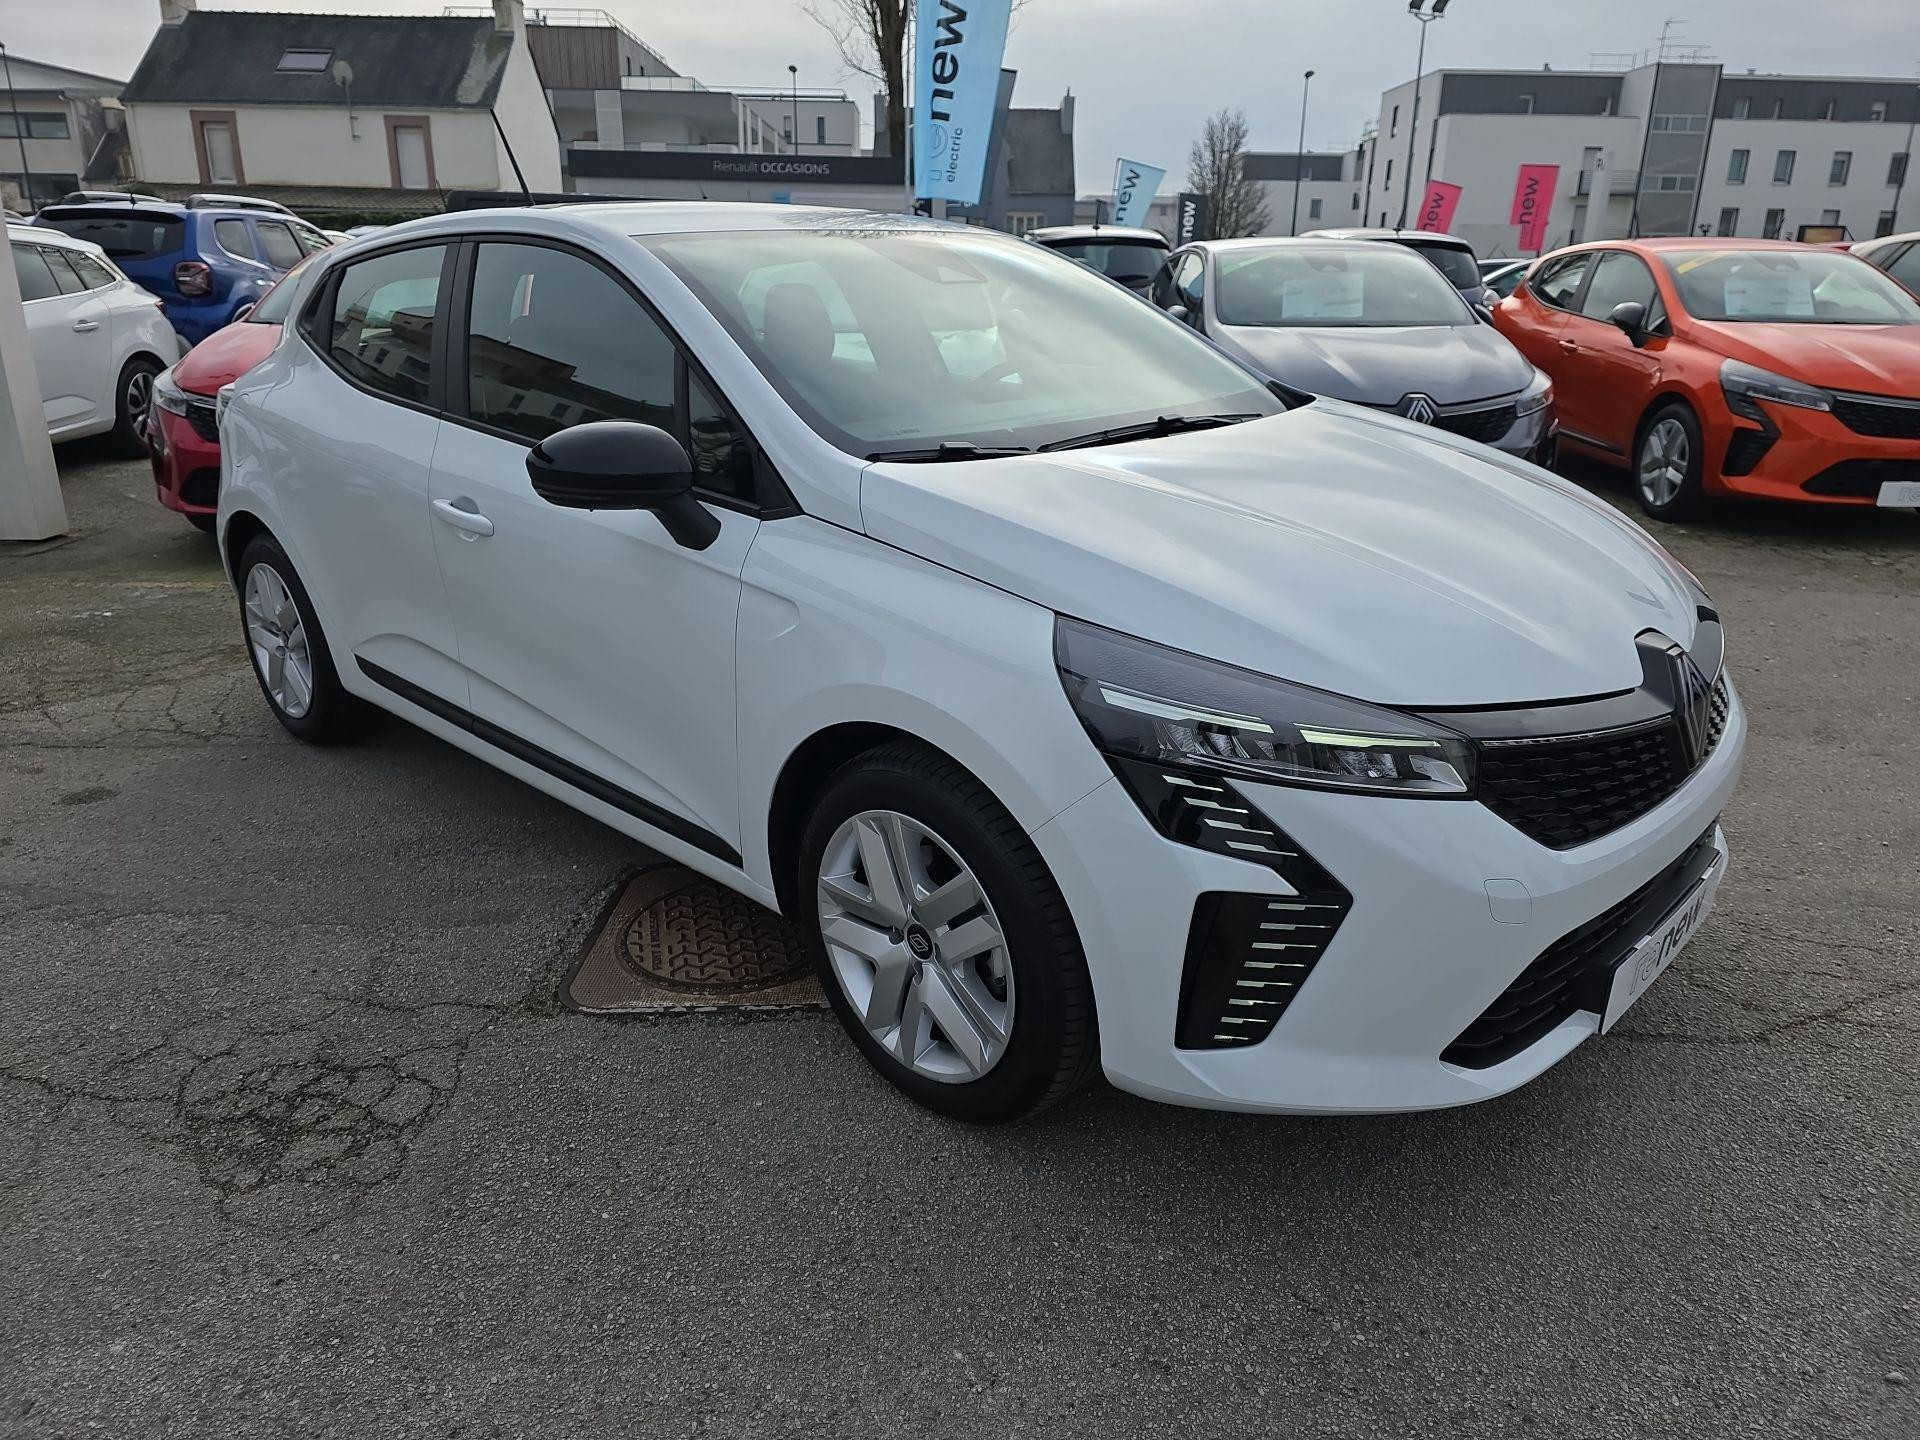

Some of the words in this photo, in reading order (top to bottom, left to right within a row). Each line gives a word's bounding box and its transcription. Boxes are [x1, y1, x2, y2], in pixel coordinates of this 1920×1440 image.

[713, 160, 758, 173] Renault
[760, 162, 830, 175] OCCASIONS
[946, 127, 964, 183] electric
[1115, 167, 1141, 222] new
[1181, 200, 1197, 238] new
